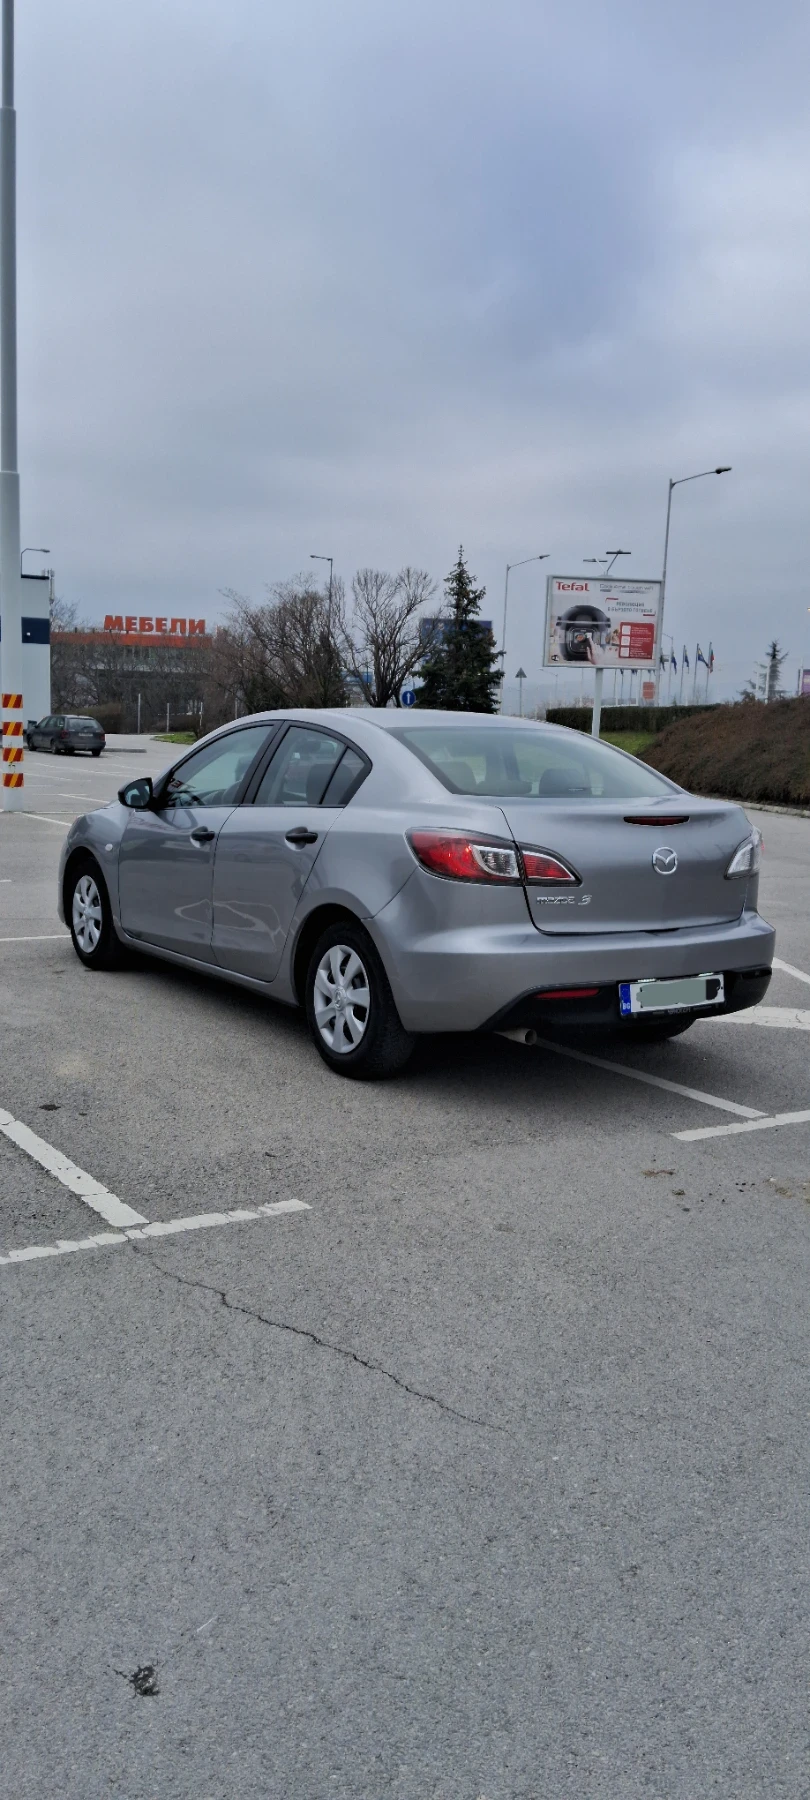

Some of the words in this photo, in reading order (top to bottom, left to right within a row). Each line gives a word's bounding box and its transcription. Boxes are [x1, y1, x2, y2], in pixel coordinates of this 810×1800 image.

[556, 581, 590, 592] Tefal
[104, 615, 205, 634] МЕБЕЛИ
[578, 894, 593, 906] 3
[622, 1002, 631, 1010] BG
